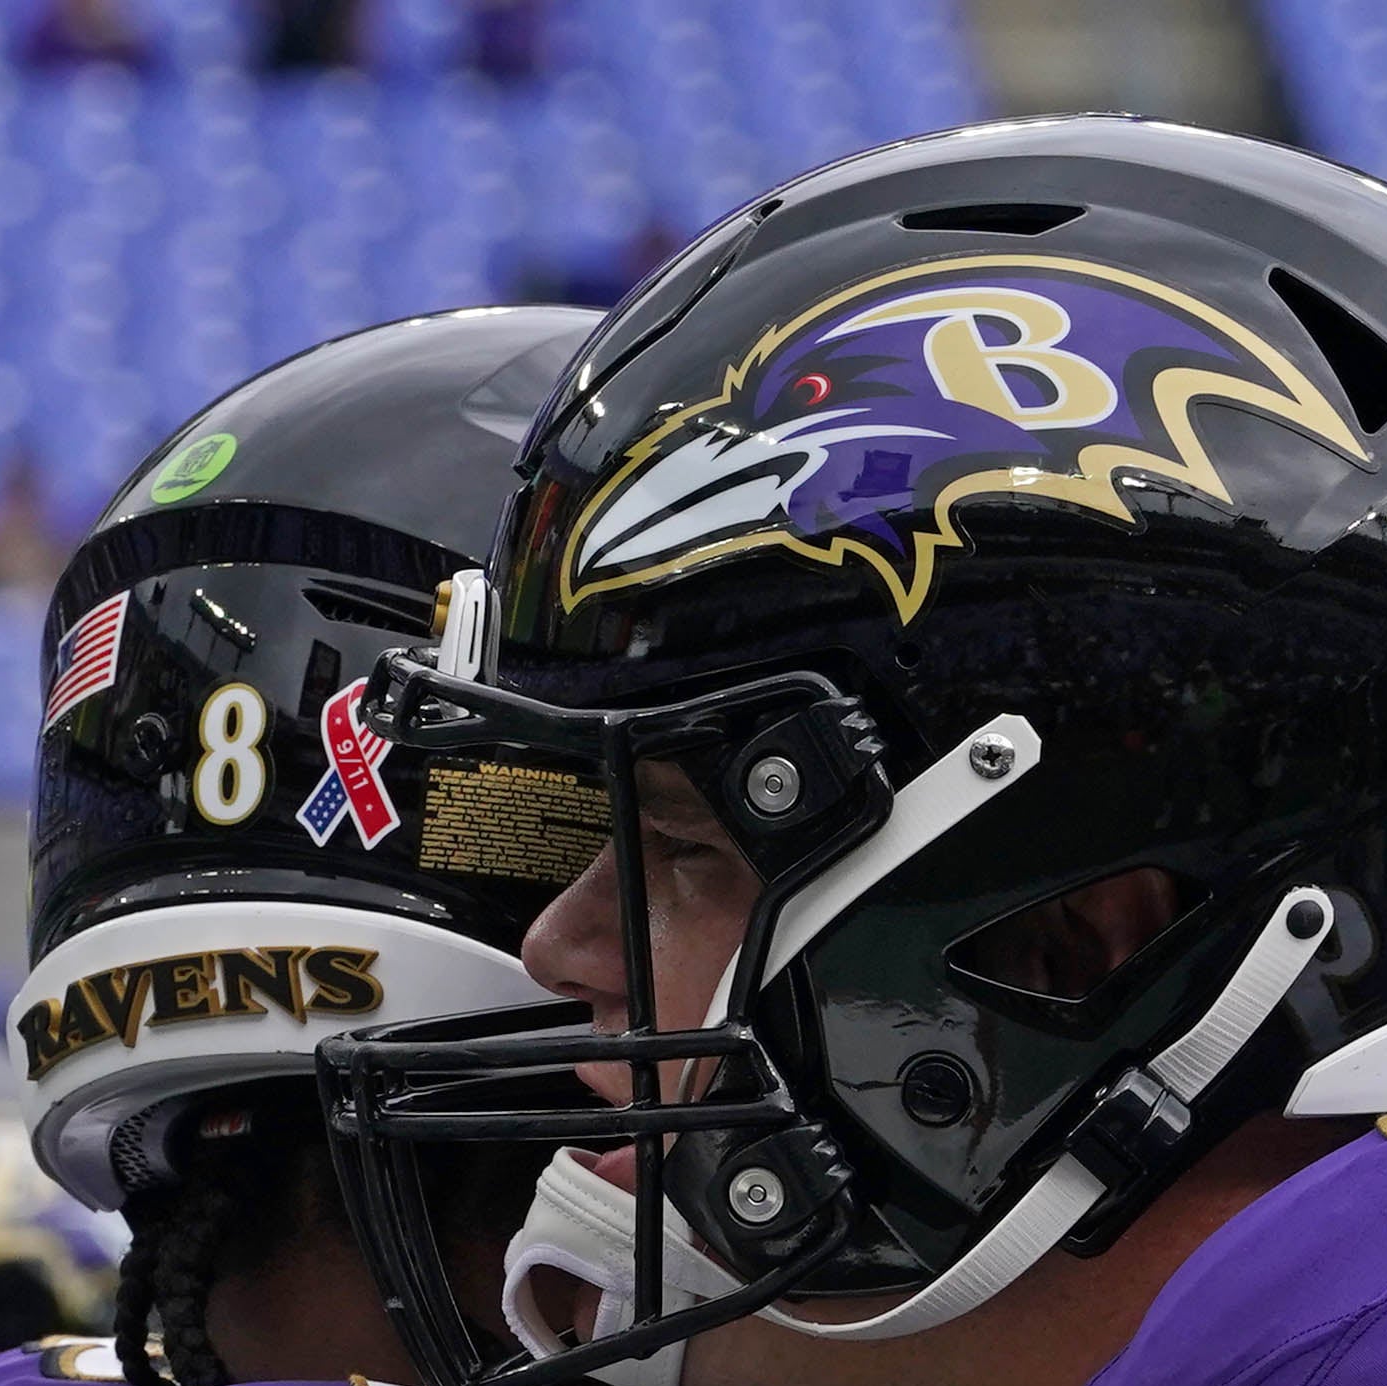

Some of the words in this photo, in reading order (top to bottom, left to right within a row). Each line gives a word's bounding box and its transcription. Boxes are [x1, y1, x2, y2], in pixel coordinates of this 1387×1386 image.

[193, 682, 268, 826] 8
[338, 740, 367, 791] 9/11
[479, 764, 576, 785] WARNING
[17, 945, 385, 1081] RAVENS
